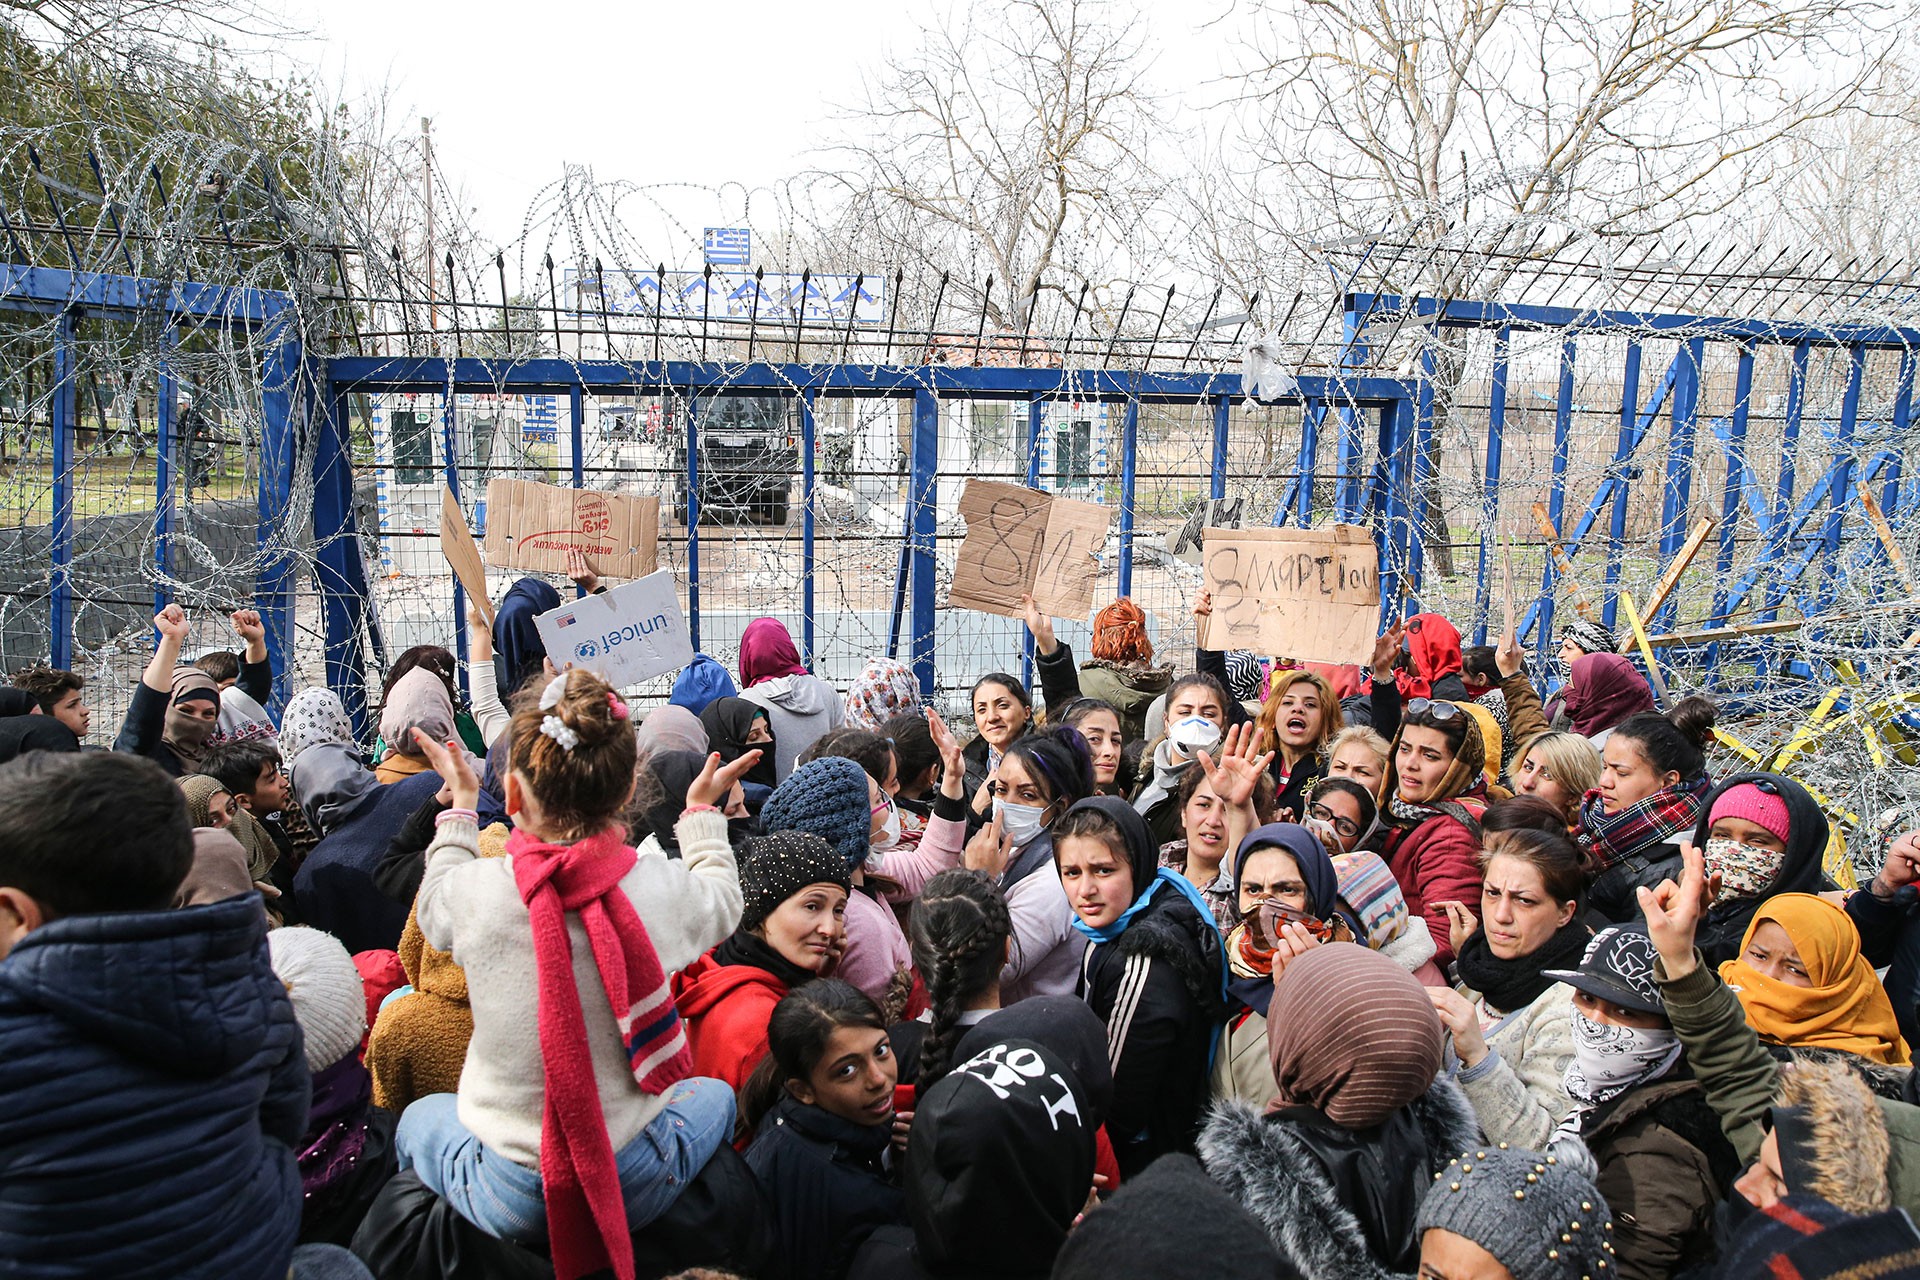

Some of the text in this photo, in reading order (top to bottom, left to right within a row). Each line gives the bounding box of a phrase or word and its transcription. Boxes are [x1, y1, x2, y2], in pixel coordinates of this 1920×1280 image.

[532, 540, 613, 556] MERİÇ TAUKÇULUK
[601, 615, 668, 654] unicef
